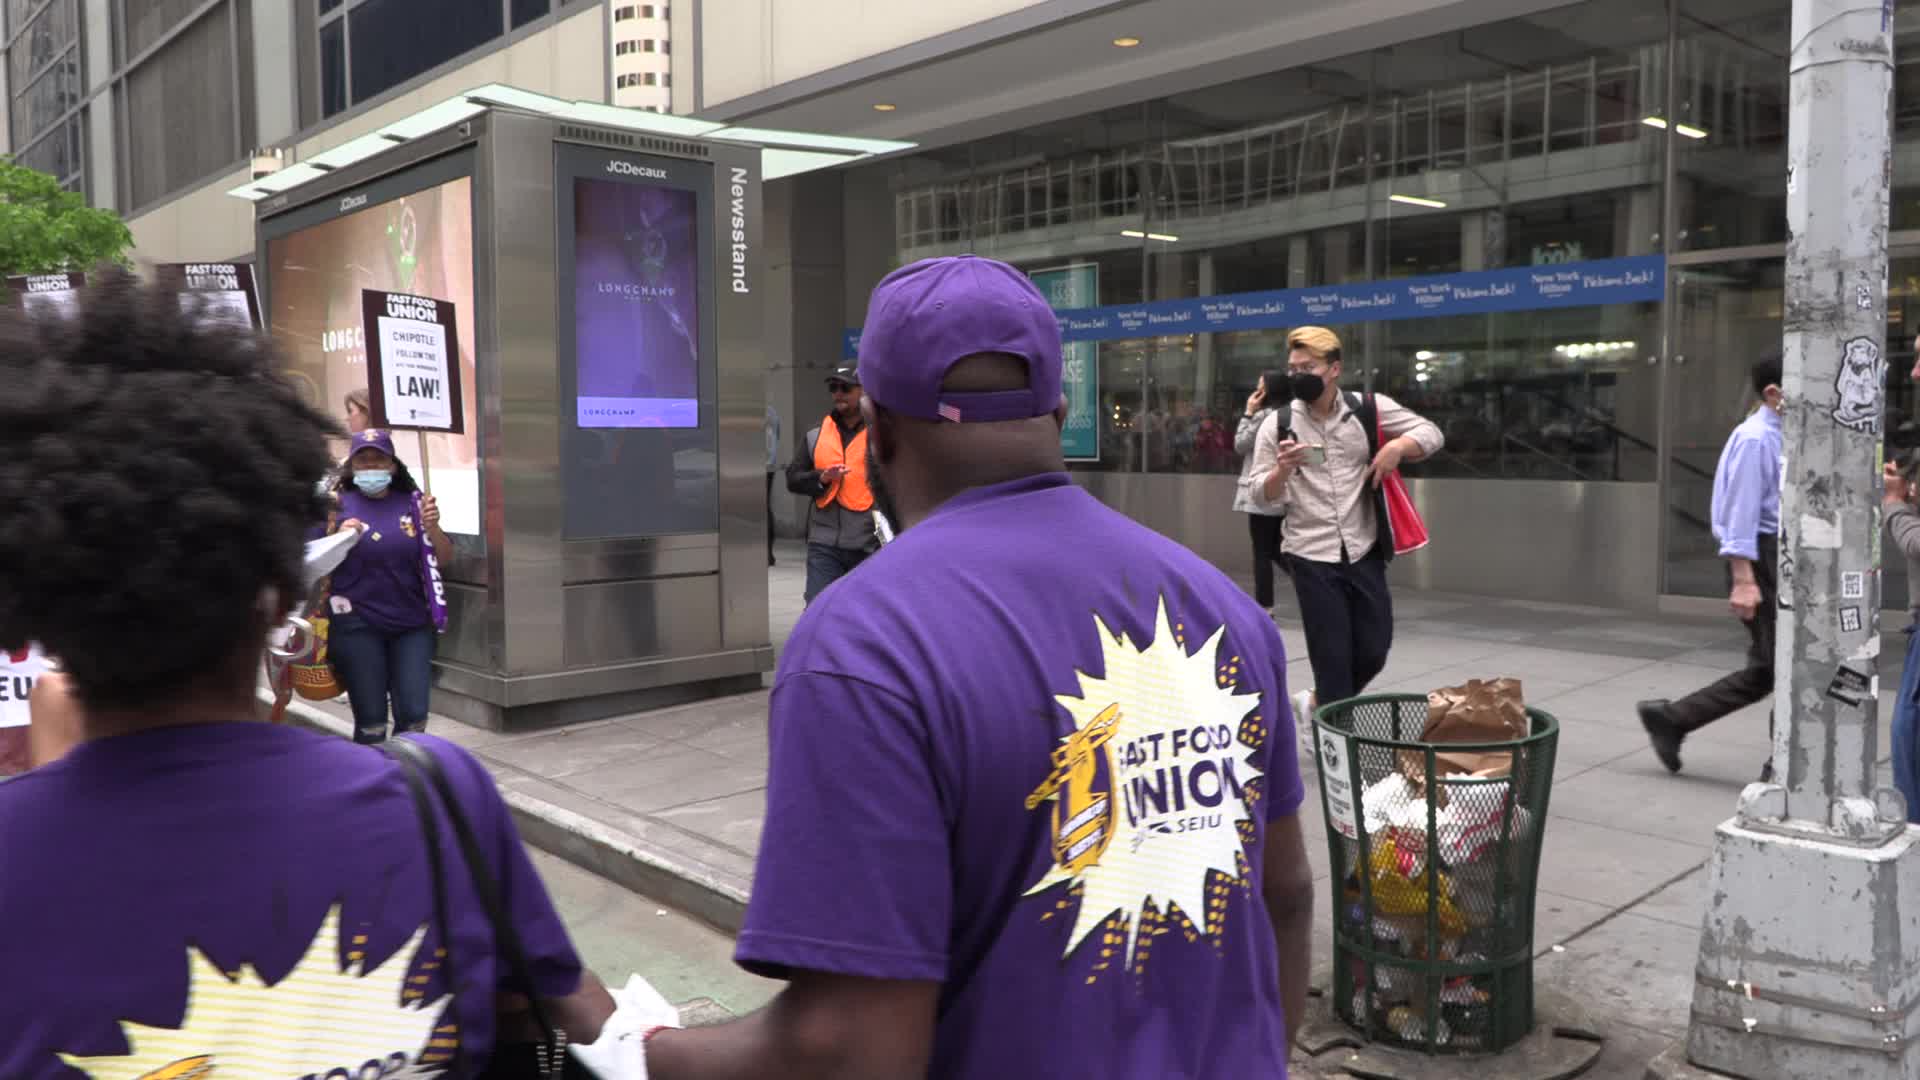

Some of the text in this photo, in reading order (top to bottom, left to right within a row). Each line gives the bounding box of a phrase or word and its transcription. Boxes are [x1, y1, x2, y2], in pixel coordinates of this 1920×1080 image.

[606, 160, 667, 180] JCDecaux
[731, 167, 749, 294] Newsstand
[185, 264, 236, 275] FAST FOOD
[27, 280, 71, 293] UNION
[387, 294, 436, 309] FAST FOOD
[387, 302, 437, 322] UNION
[323, 327, 362, 352] LONGC
[392, 331, 435, 346] CHIPOTLE
[396, 375, 440, 400] LAW!
[1176, 814, 1223, 833] SEIU
